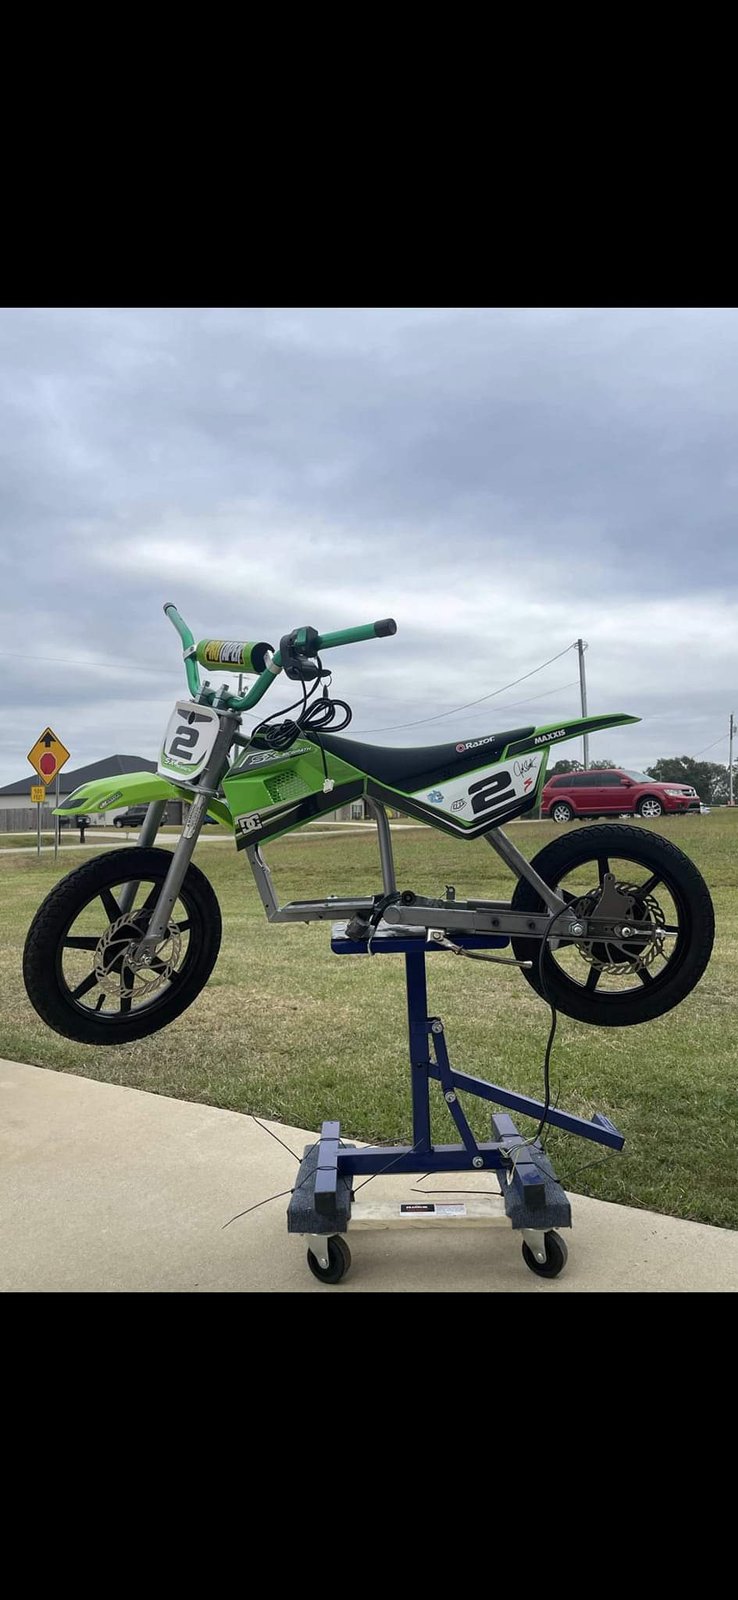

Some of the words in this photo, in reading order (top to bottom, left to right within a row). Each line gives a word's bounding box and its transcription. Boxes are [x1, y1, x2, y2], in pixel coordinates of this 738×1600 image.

[169, 725, 200, 761] 2
[464, 736, 496, 751] Razor
[534, 729, 567, 745] MAXXIS
[468, 770, 517, 815] 2
[238, 813, 262, 834] DC
